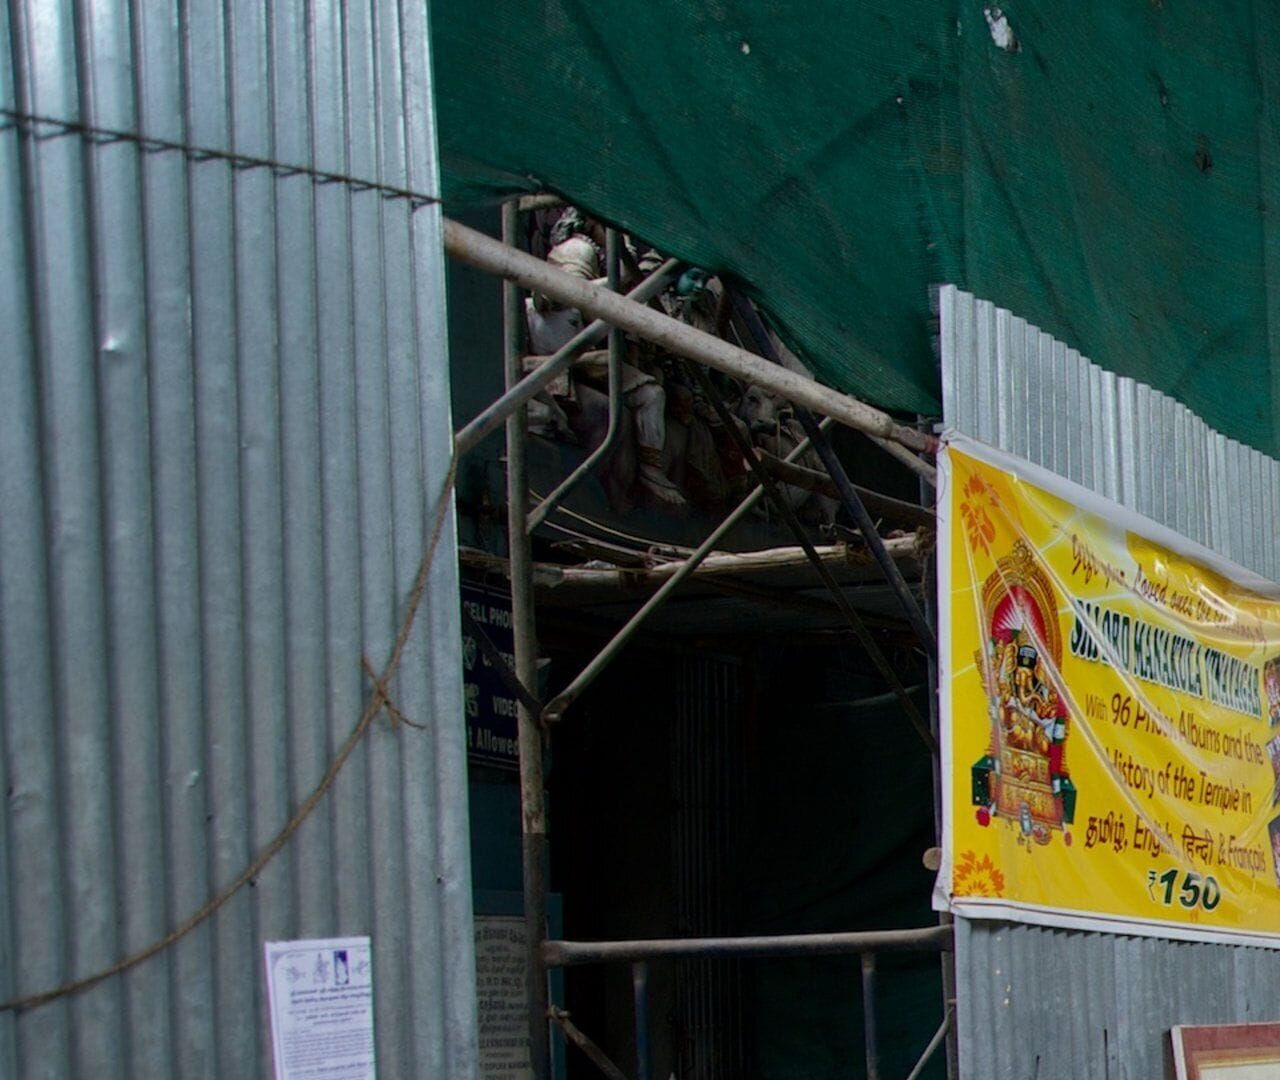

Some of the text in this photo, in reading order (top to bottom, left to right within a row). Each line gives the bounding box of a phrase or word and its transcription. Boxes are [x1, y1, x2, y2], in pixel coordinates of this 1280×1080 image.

[1132, 619, 1203, 700] MANAKULA
[1112, 692, 1131, 727] 96
[1178, 709, 1221, 757] Albums
[1223, 727, 1243, 763] and
[1244, 733, 1264, 766] the
[1157, 761, 1172, 794] of
[1173, 766, 1195, 805] the
[1199, 771, 1240, 815] Temple
[1241, 783, 1252, 815] in
[1217, 832, 1227, 866] &
